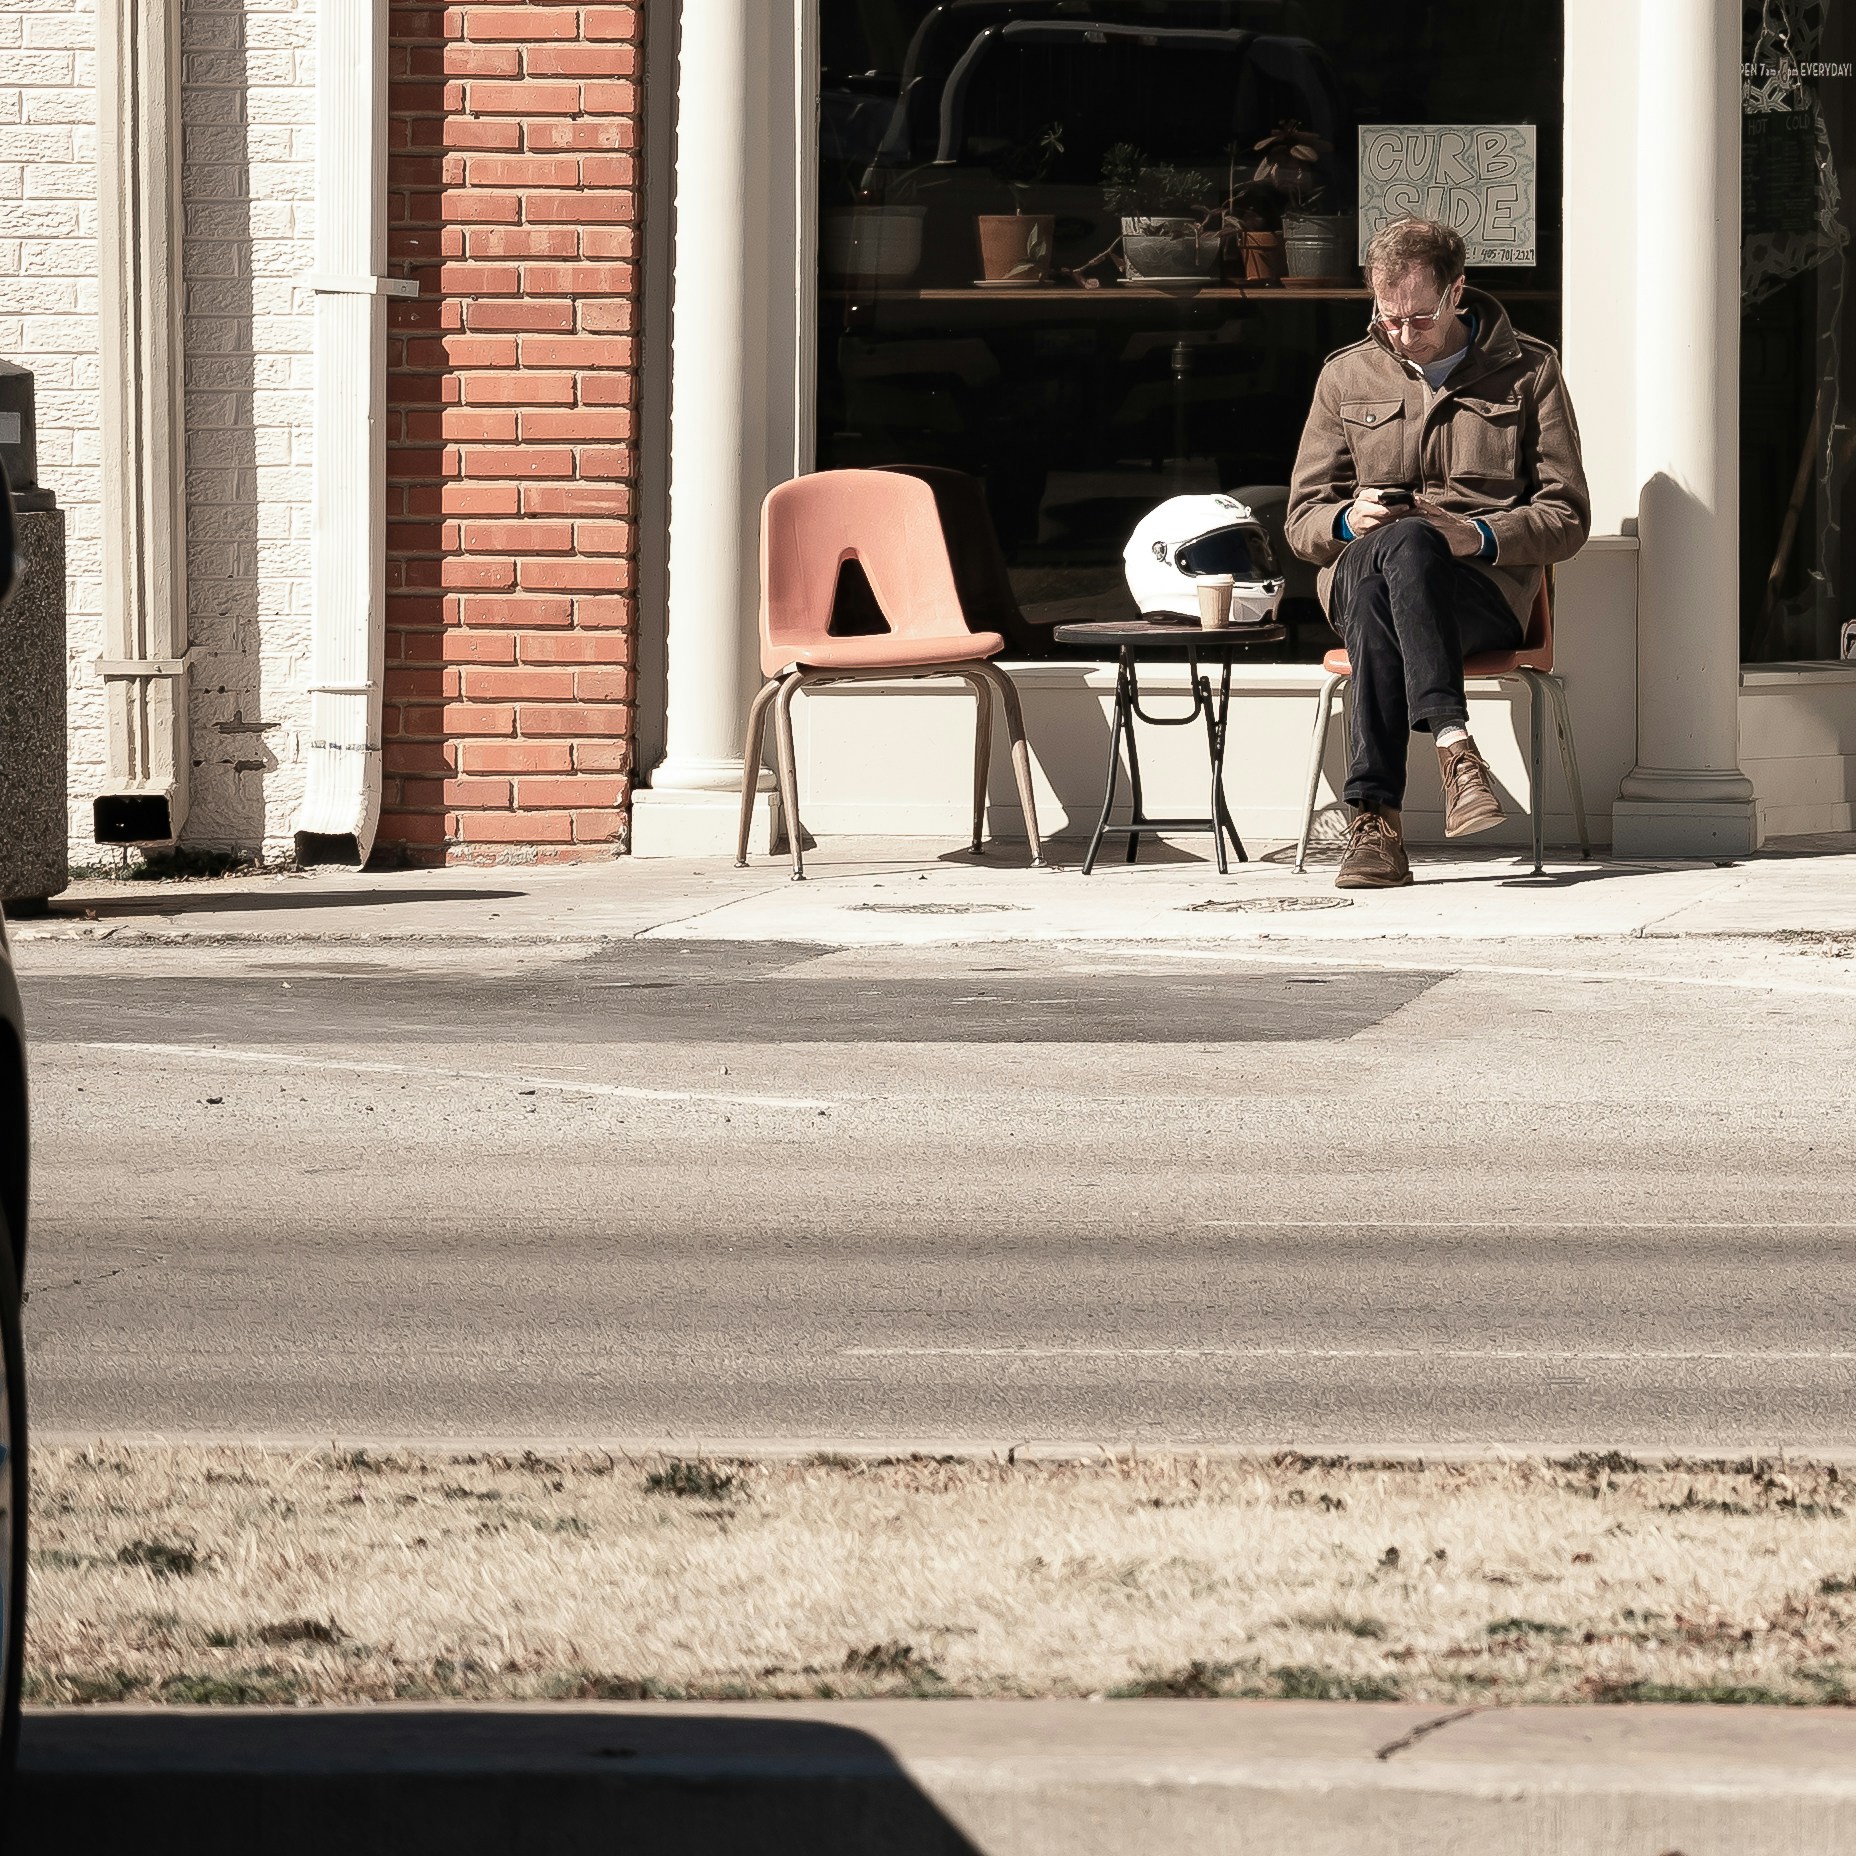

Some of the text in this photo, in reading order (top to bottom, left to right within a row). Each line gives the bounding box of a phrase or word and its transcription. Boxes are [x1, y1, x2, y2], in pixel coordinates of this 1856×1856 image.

[1800, 62, 1853, 77] EVERYDAY!
[1368, 131, 1518, 186] CURB
[1374, 183, 1519, 242] SIDE
